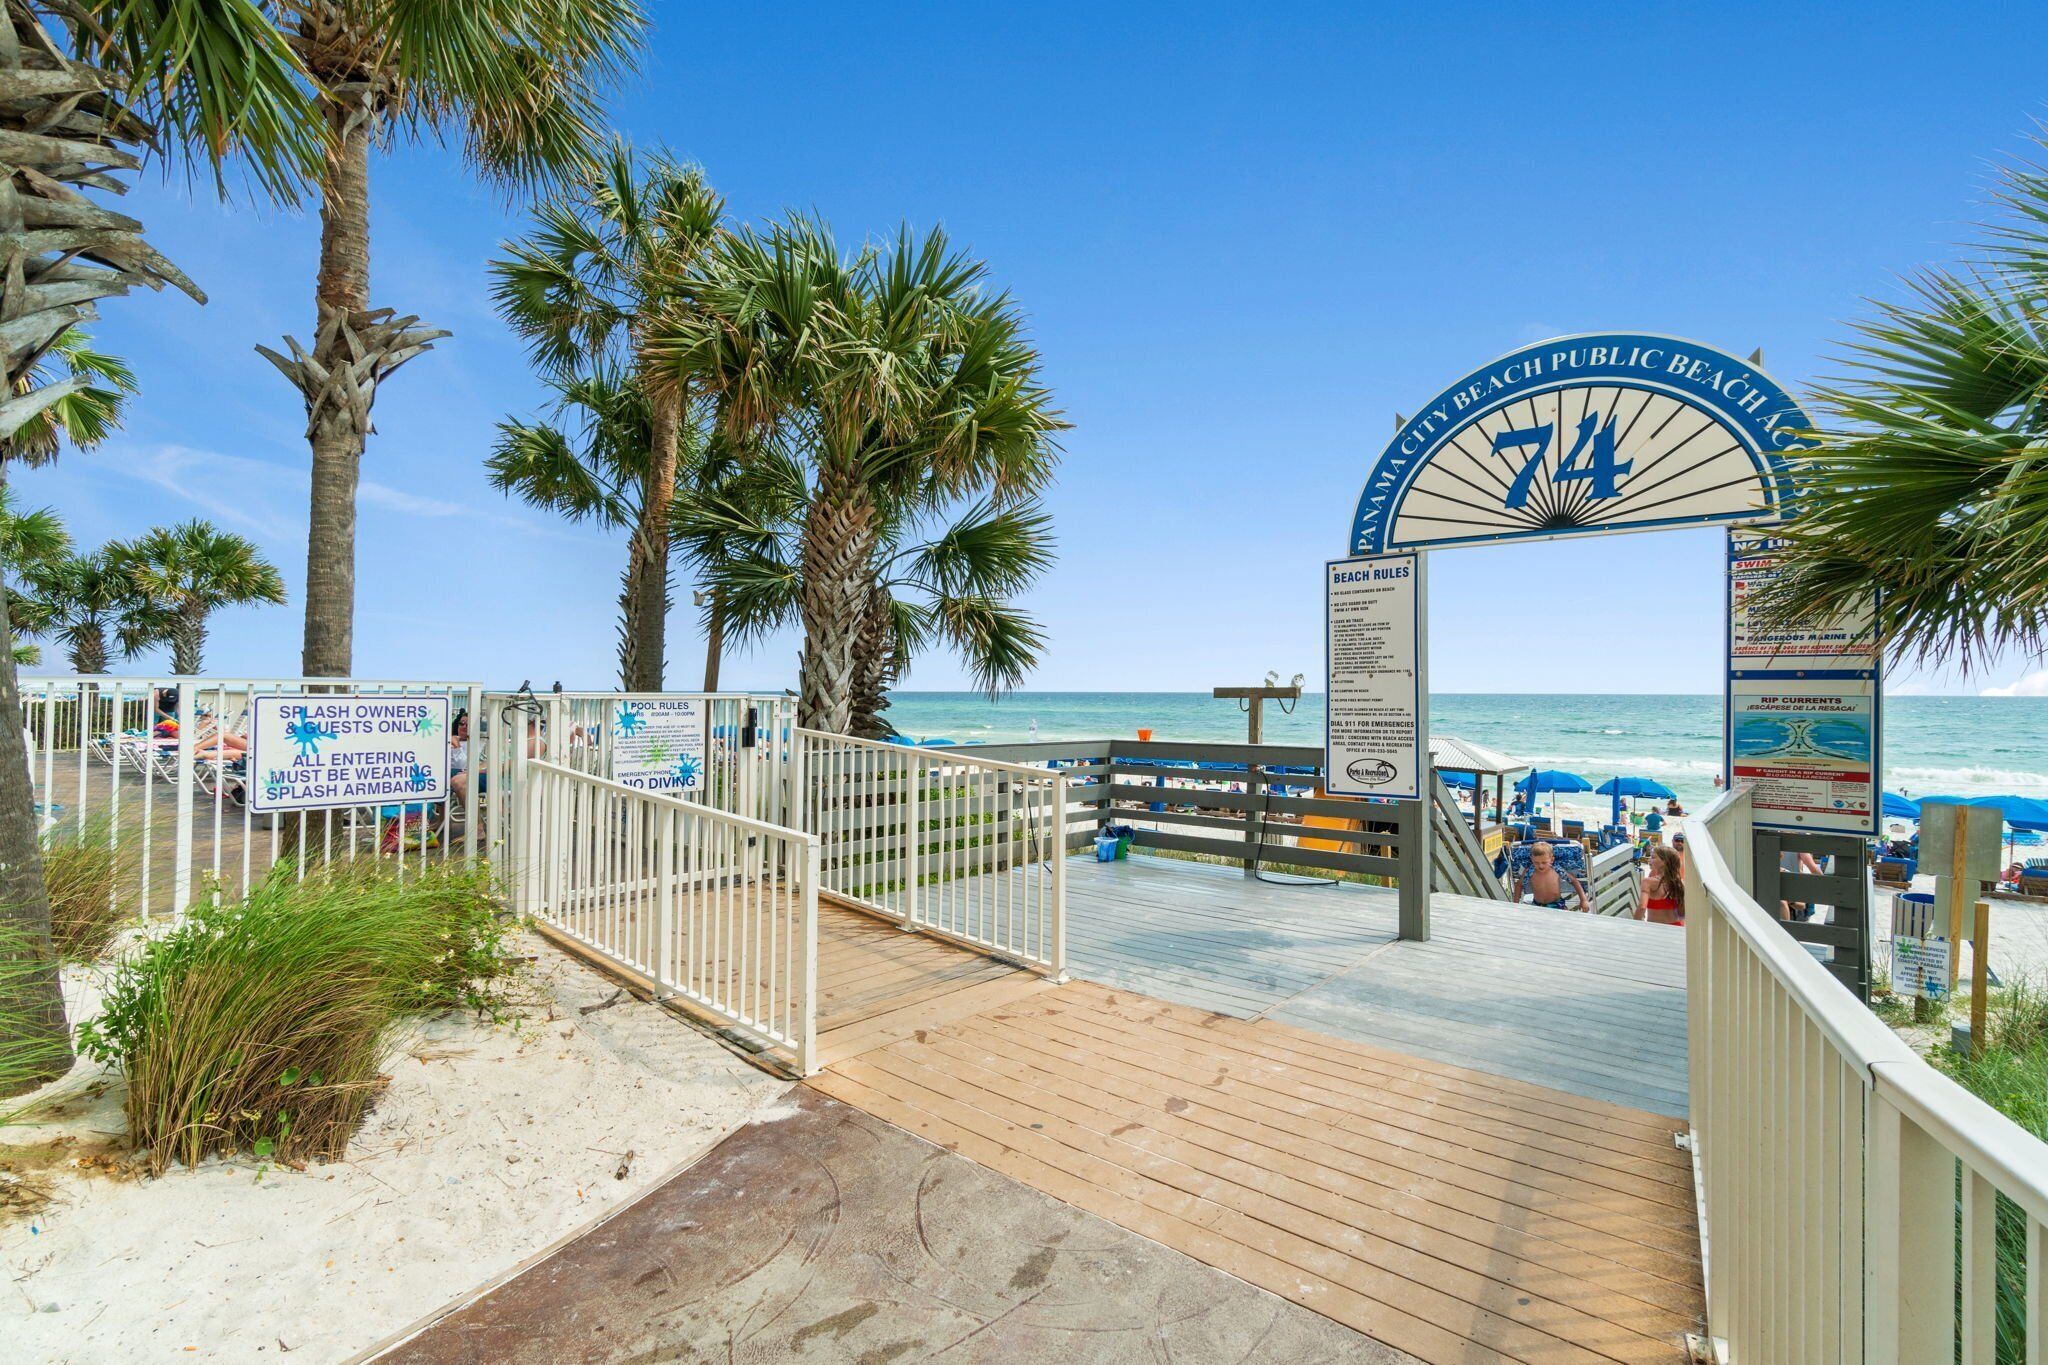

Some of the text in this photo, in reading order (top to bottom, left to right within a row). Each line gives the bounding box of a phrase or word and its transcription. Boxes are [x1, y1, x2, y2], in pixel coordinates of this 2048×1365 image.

[1358, 459, 1406, 550] PANAMA
[1401, 403, 1449, 455] CITY
[1452, 357, 1543, 411] BEACH
[1551, 346, 1664, 372] PUBLIC
[1666, 353, 1768, 414] BEACH
[1491, 410, 1634, 509] 74
[1736, 560, 1772, 568] SWIM
[1334, 567, 1409, 583] BEACH RULES
[280, 705, 428, 719] SPLASH OWNERS
[285, 720, 421, 734] & GUESTS ONLY
[292, 751, 416, 768] ALL ENTERING
[271, 765, 432, 785] MUST BE WEARING
[649, 776, 695, 789] DIVING
[266, 779, 437, 801] SPLASH ARMBANDS
